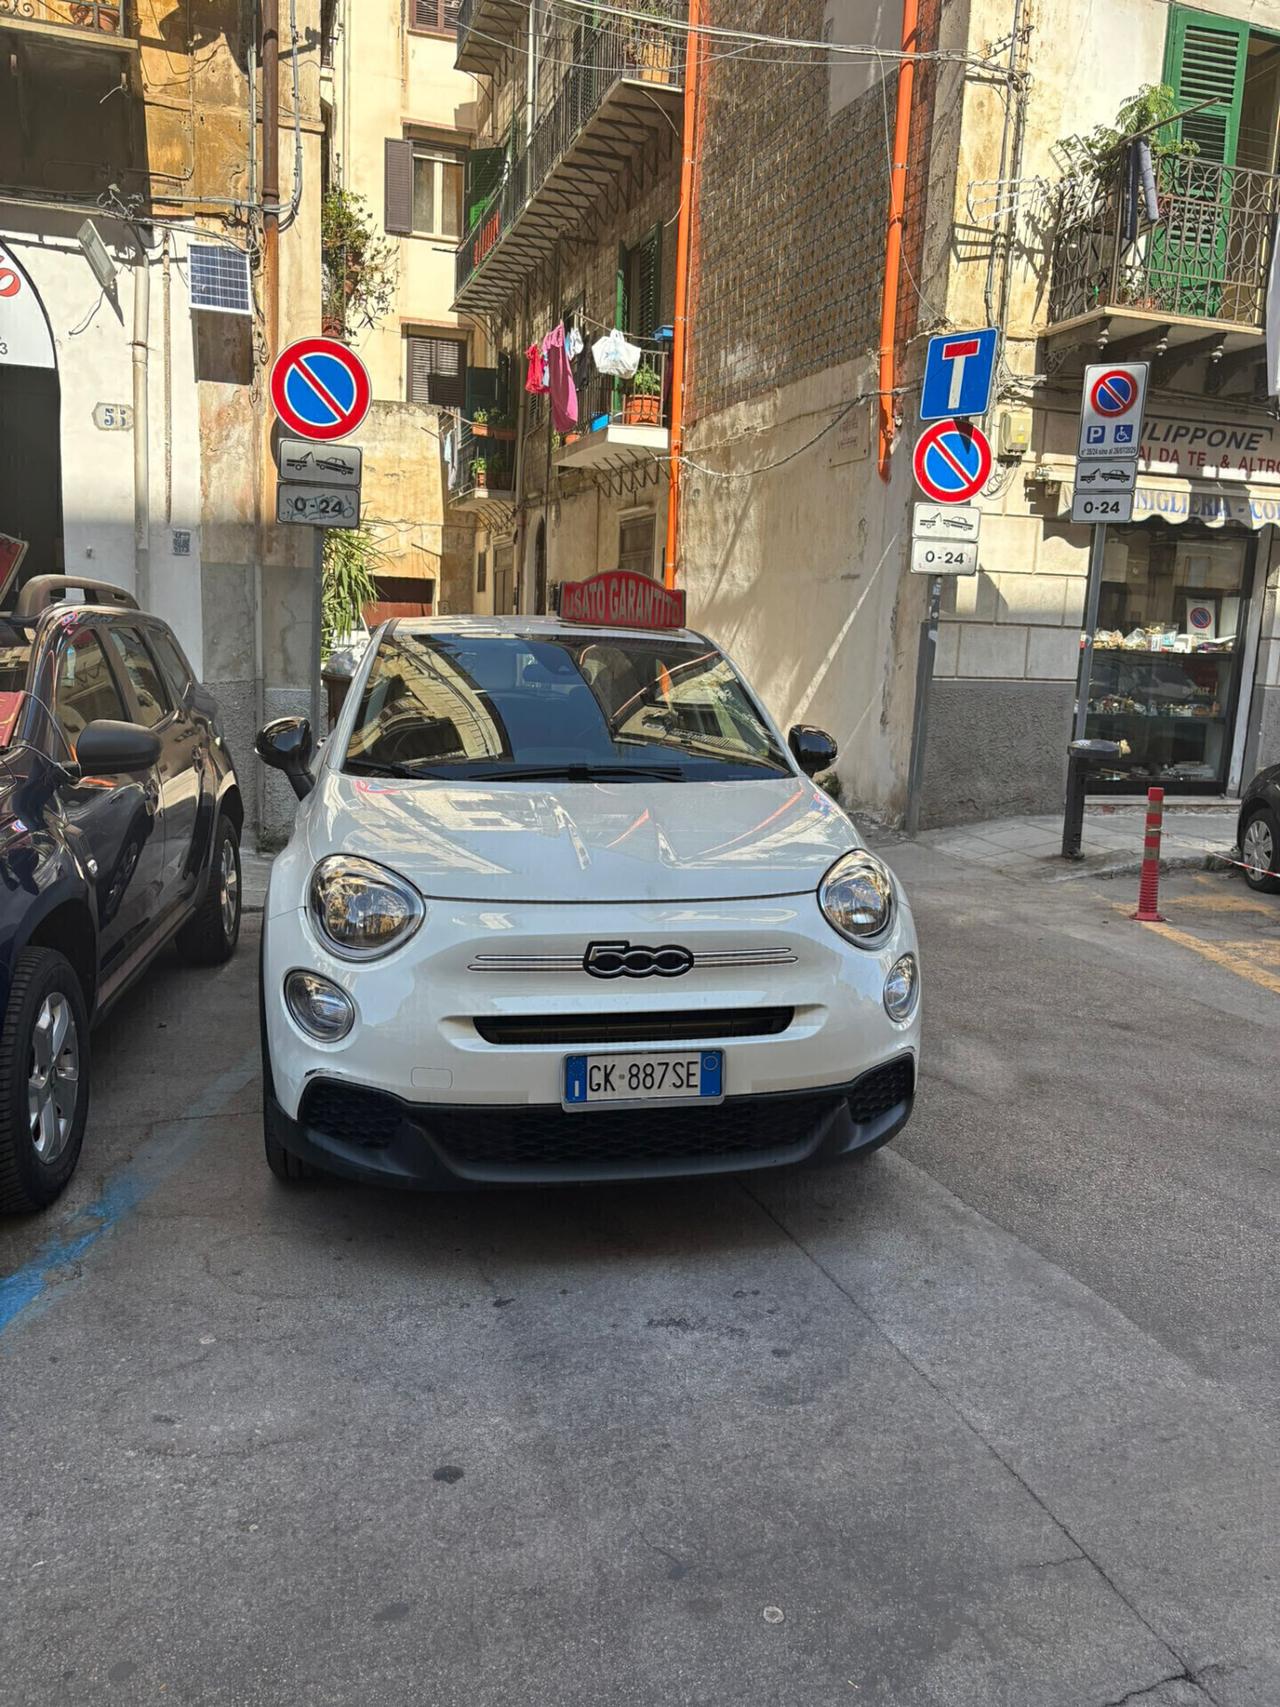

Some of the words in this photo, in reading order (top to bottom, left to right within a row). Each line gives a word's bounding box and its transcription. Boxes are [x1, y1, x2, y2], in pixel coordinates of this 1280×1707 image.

[1089, 427, 1102, 443] P
[1140, 422, 1263, 451] ILIPPONE
[1139, 445, 1151, 461] AI
[1159, 448, 1180, 465] DA
[1133, 489, 1232, 518] NIGLIERIA
[1250, 500, 1280, 519] CO
[564, 580, 606, 618] USATO
[609, 577, 681, 625] GARANTITO
[584, 941, 694, 979] 500
